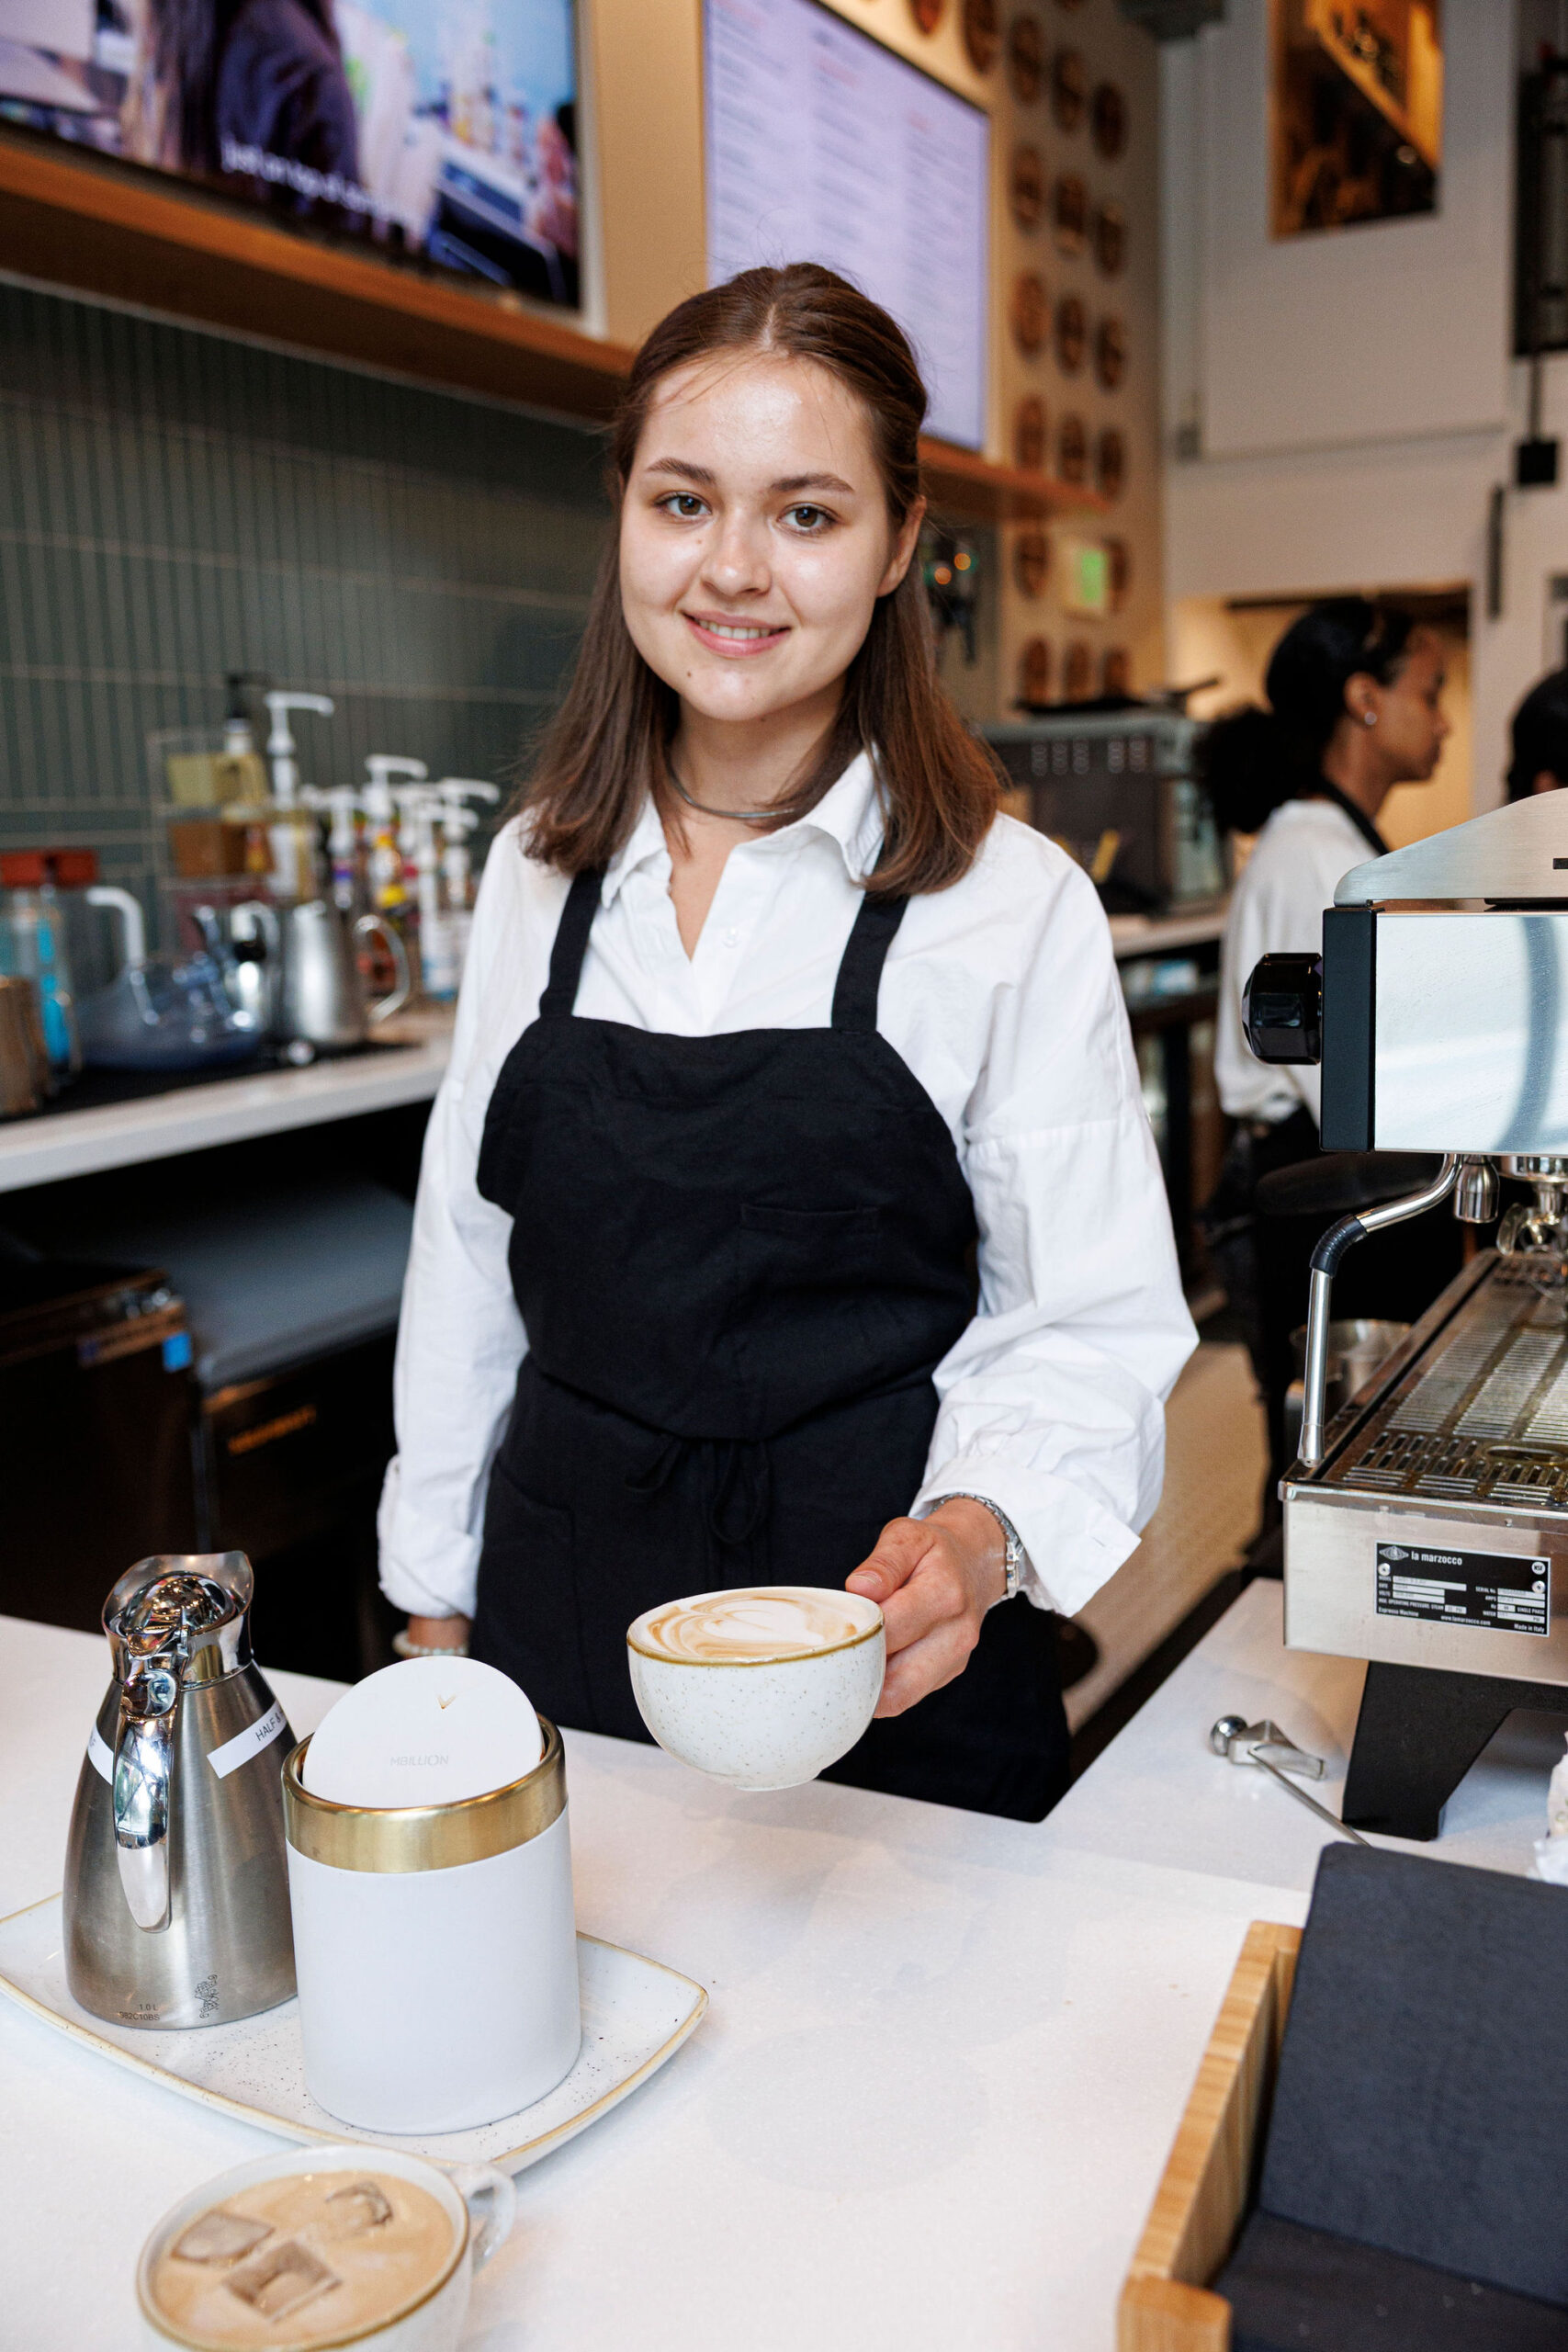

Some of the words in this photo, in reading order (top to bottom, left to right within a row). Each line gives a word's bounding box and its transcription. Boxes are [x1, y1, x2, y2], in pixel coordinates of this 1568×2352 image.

[1411, 1551, 1419, 1561] la
[1421, 1553, 1462, 1566] marzocco
[1378, 1606, 1399, 1615] Espresso
[1399, 1609, 1419, 1617] Machine
[1440, 1615, 1491, 1626] www.lamarzocco.com
[1514, 1623, 1528, 1631] Made
[1533, 1625, 1545, 1634] Italy
[255, 1717, 276, 1741] HALF
